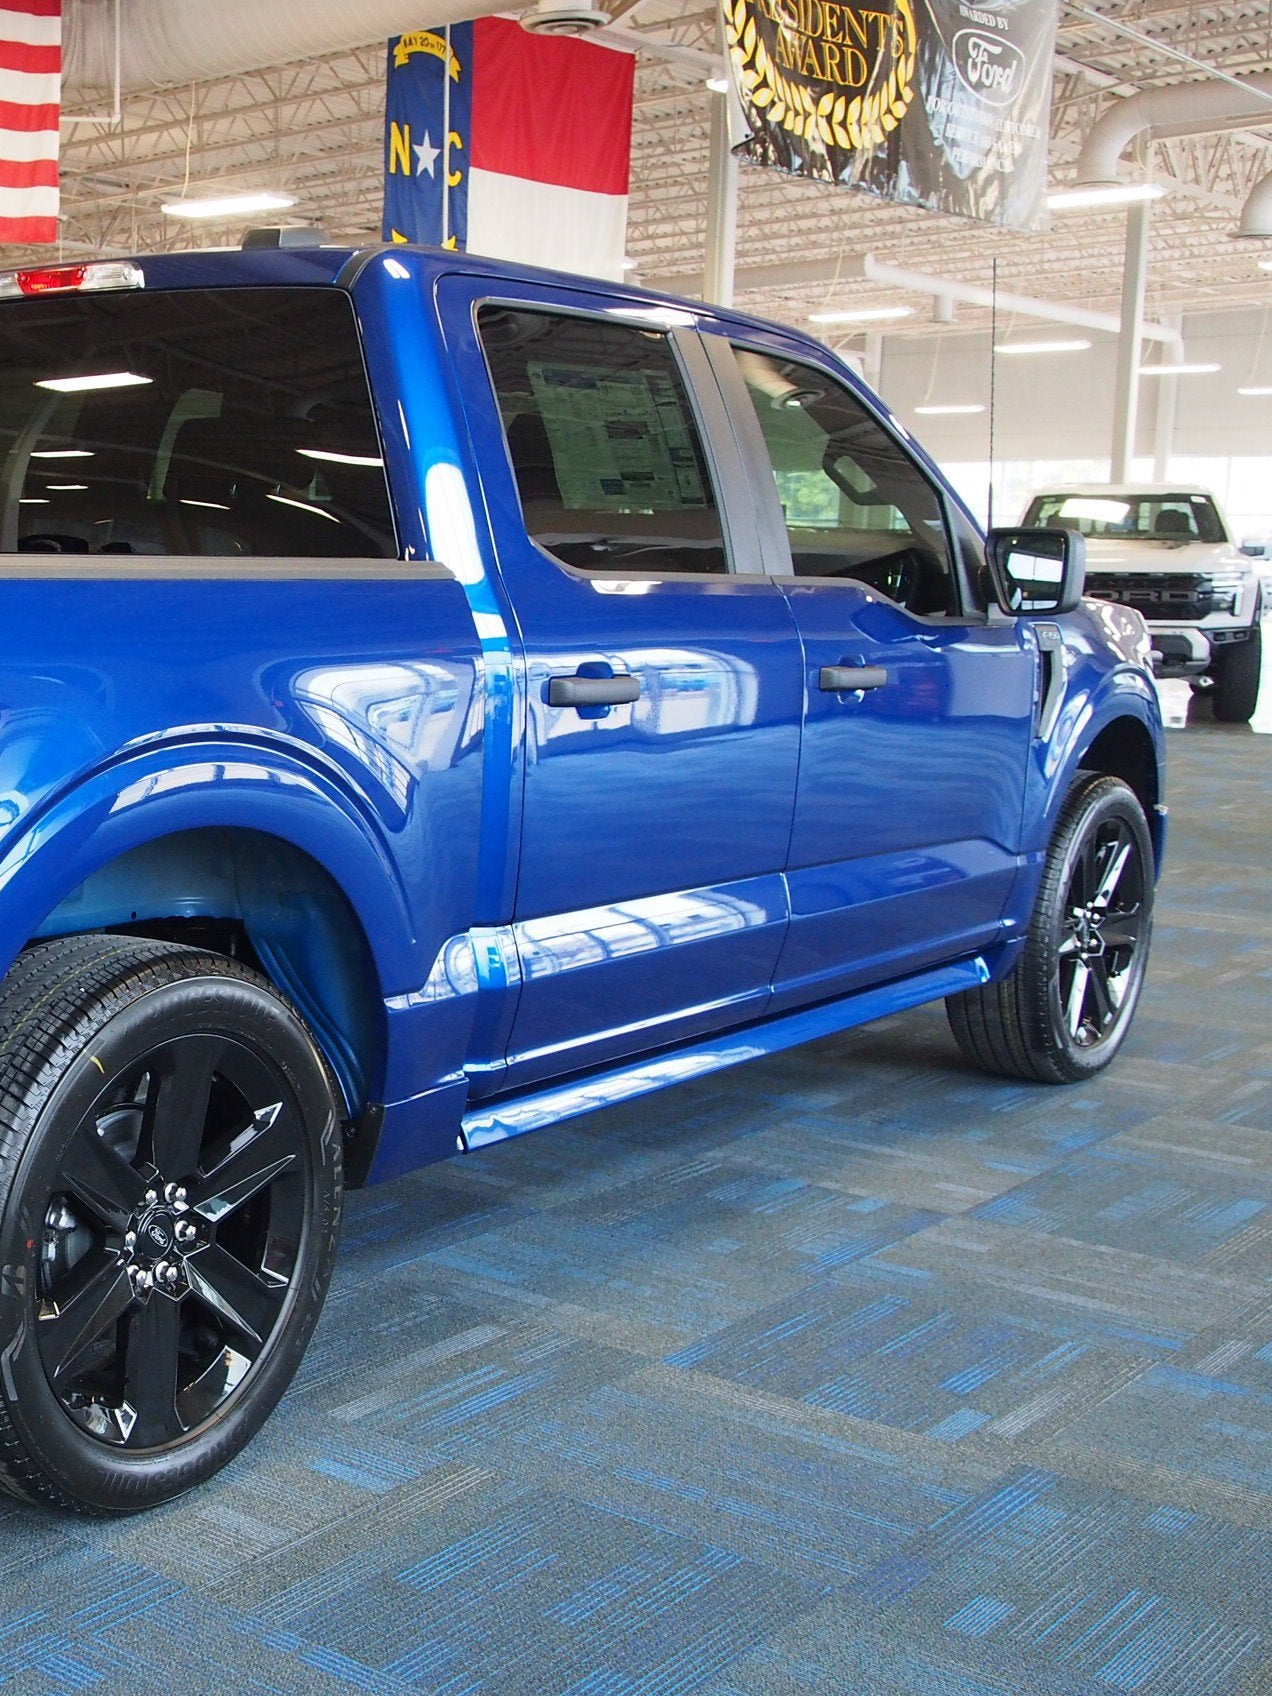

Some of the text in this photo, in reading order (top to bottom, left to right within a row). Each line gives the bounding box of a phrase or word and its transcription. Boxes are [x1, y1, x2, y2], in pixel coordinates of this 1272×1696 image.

[958, 5, 1009, 30] AWARDED BY
[776, 26, 867, 87] AWARD
[967, 37, 1017, 94] Ford
[389, 121, 463, 187] N C
[1083, 589, 1198, 602] ORD
